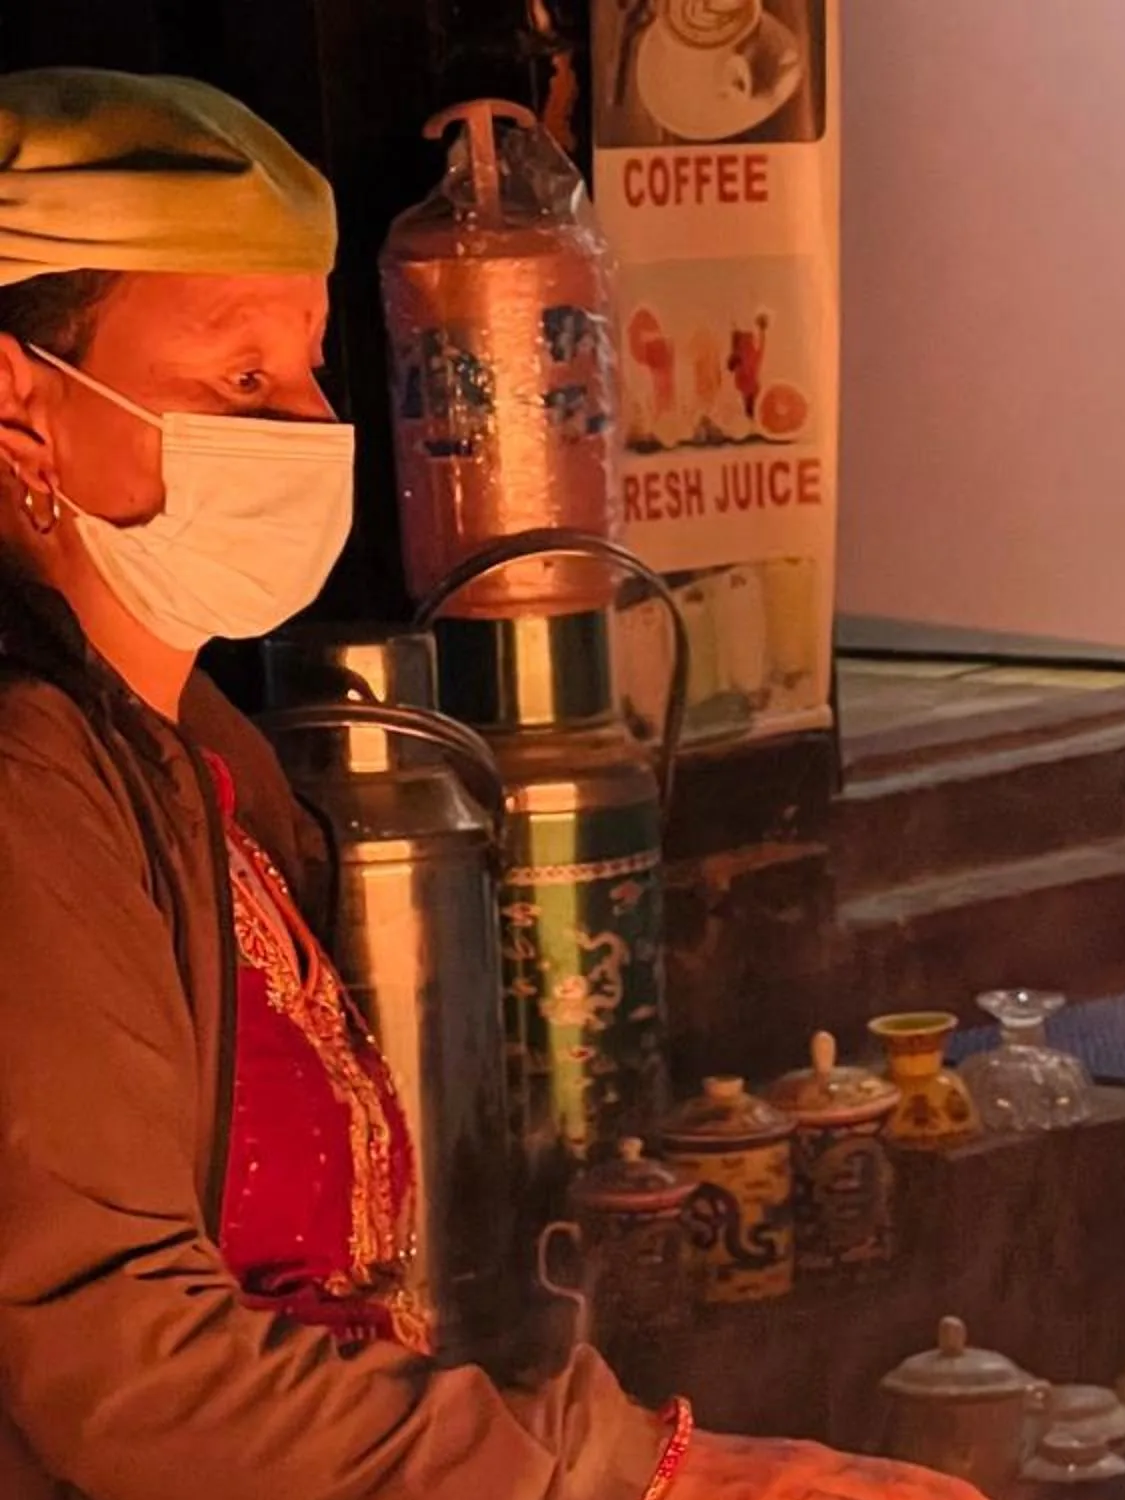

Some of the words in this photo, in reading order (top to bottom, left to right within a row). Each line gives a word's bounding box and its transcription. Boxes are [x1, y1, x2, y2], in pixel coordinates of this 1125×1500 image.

[623, 154, 768, 208] COFFEE
[623, 467, 704, 523] RESH
[714, 457, 822, 513] JUICE
